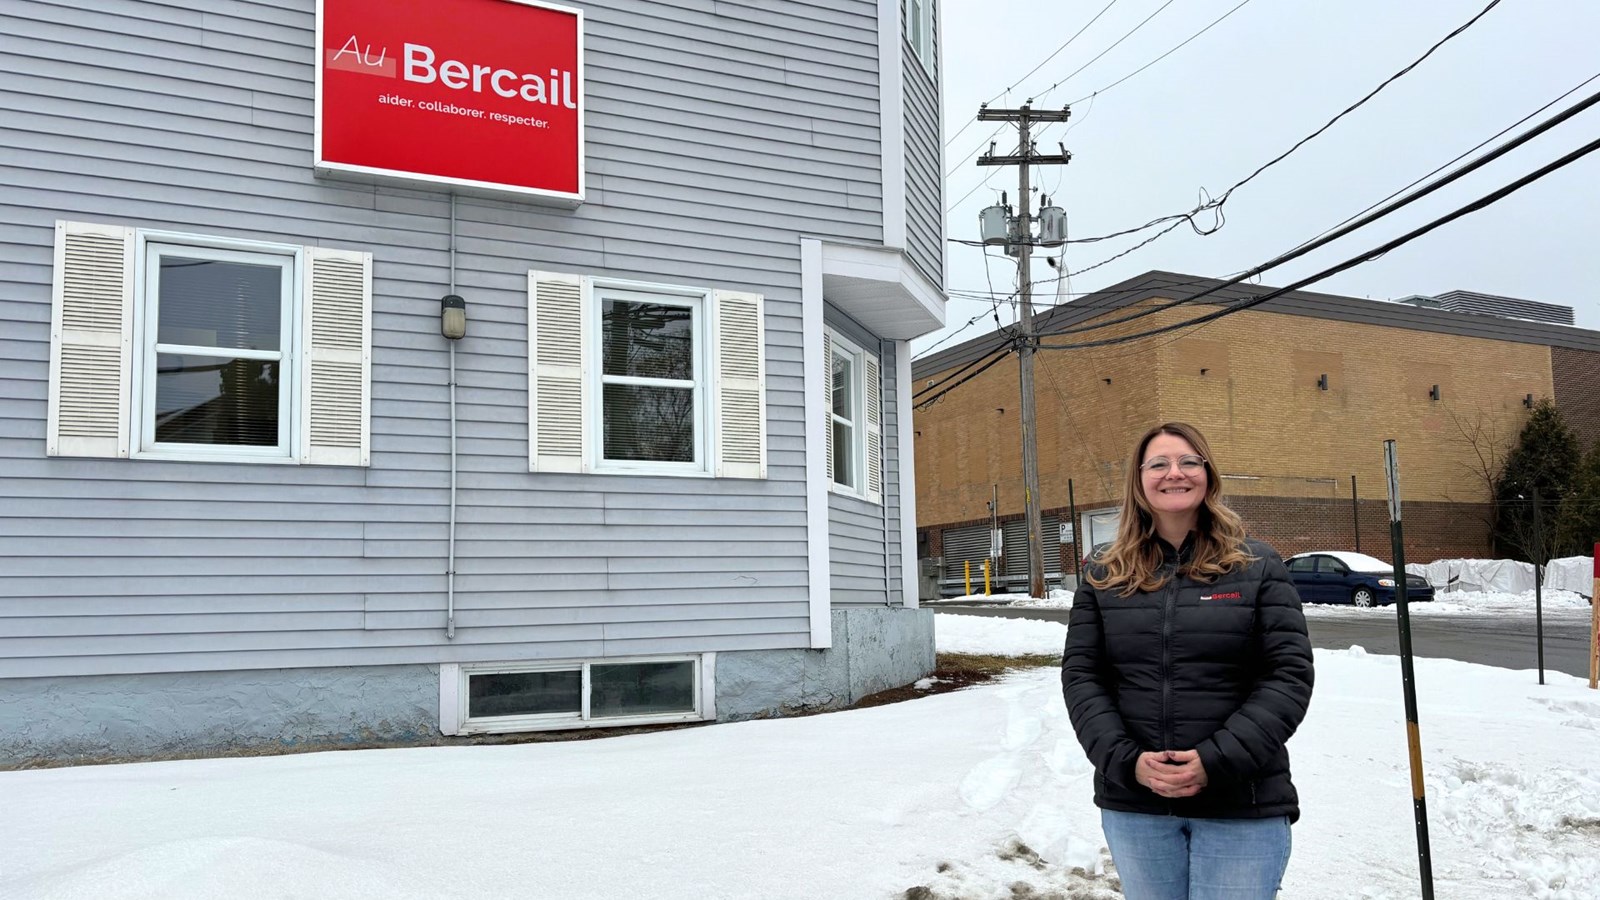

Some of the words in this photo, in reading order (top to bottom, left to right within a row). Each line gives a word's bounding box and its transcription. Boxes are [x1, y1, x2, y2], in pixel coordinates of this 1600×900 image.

[333, 35, 387, 68] Au
[403, 42, 577, 109] Bercail
[378, 93, 416, 108] aider.
[418, 100, 487, 119] collaborer.
[489, 111, 551, 129] respecter.
